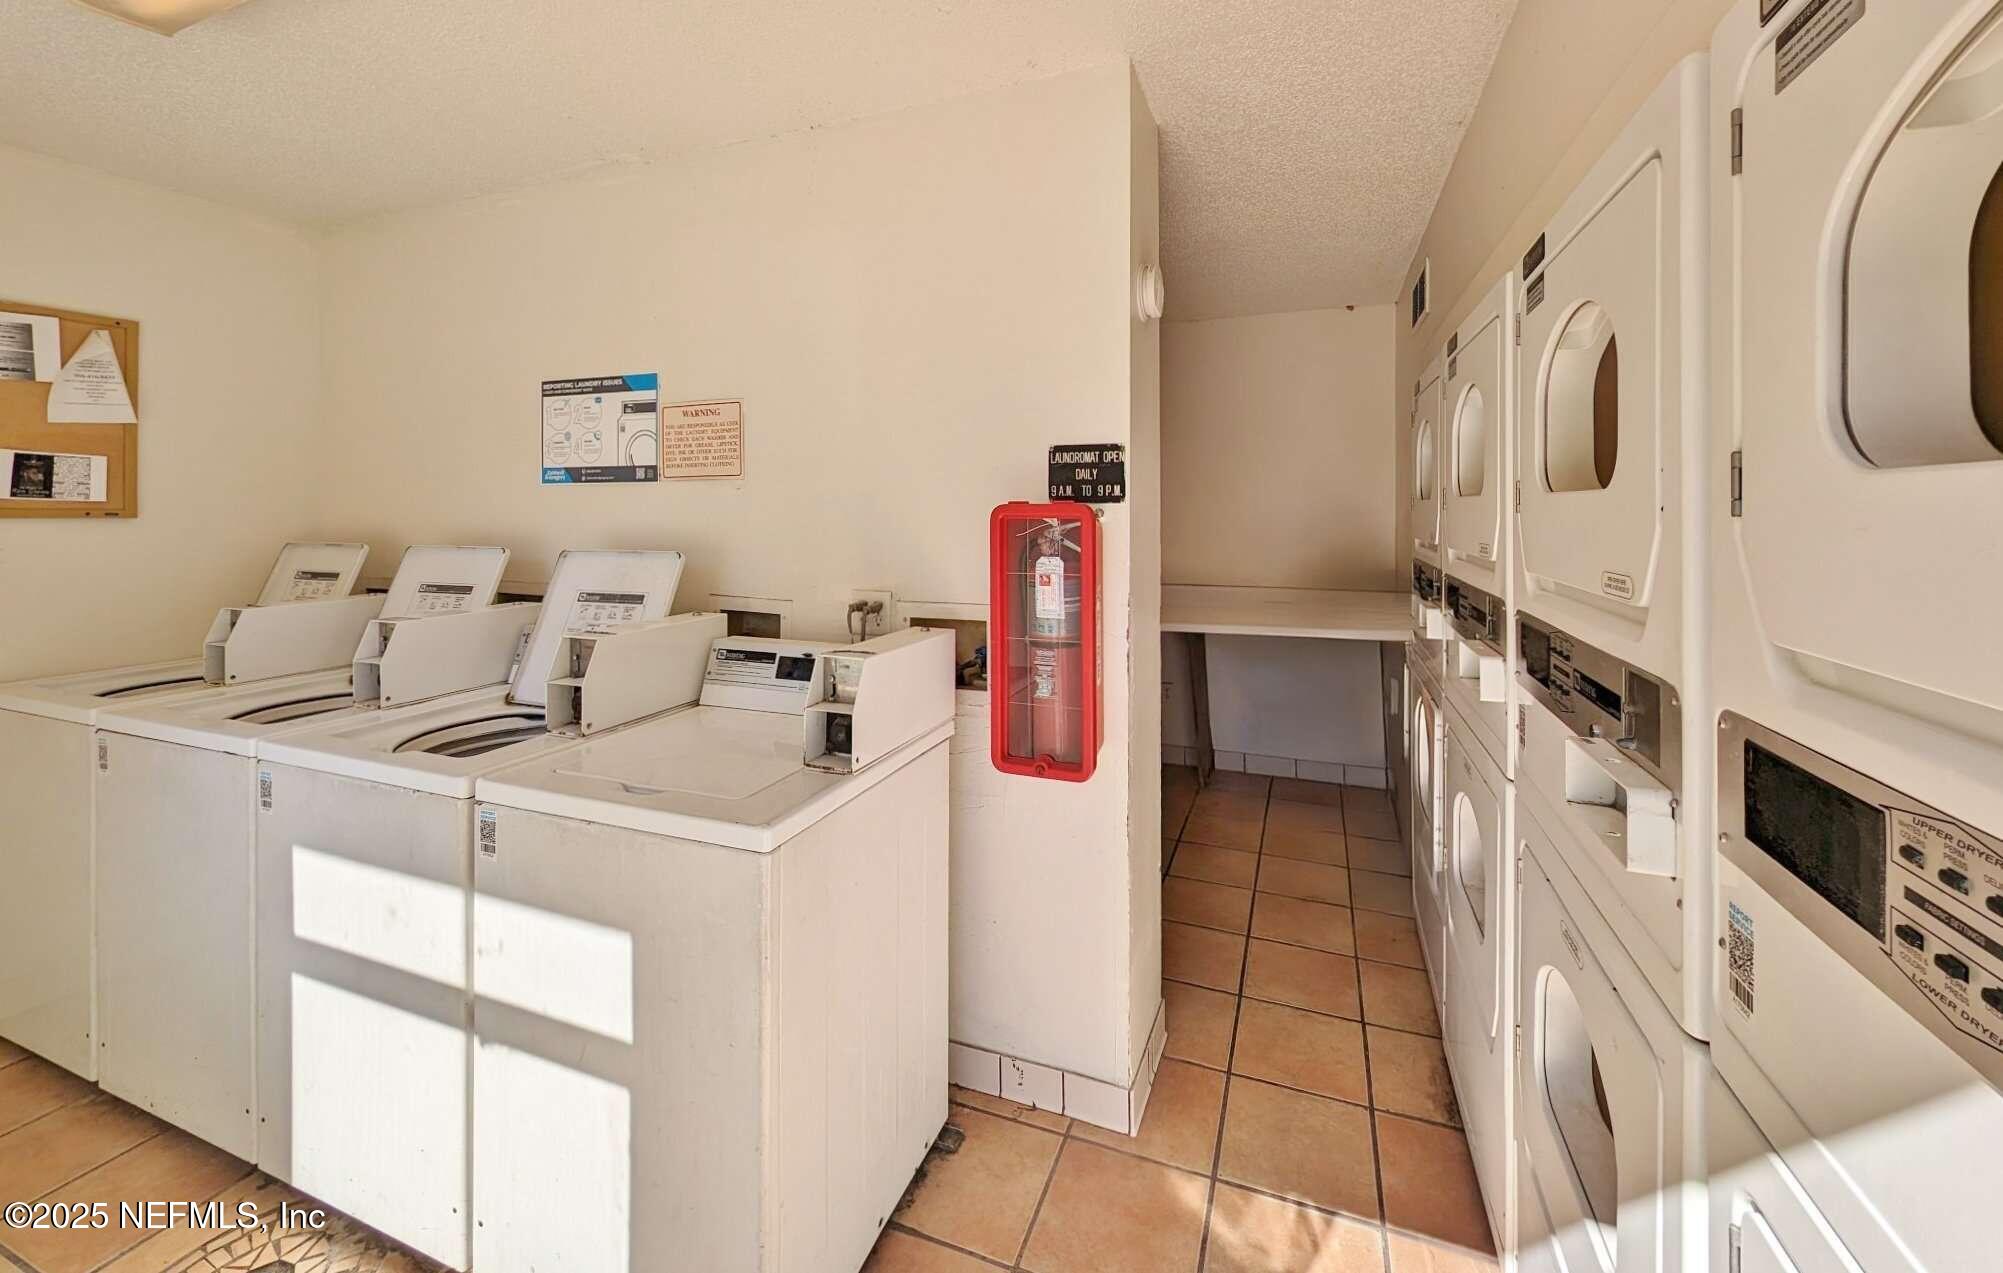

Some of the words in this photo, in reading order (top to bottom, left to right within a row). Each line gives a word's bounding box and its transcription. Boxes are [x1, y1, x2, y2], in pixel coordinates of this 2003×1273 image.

[543, 382, 573, 390] REPORTING
[682, 408, 720, 417] WARNING
[1051, 451, 1099, 464] LAUNDROMAT
[1103, 450, 1125, 463] OPEN
[1075, 468, 1098, 480] DAILY
[1051, 485, 1056, 497] 9
[1082, 485, 1092, 497] TO
[1097, 485, 1103, 496] 9
[1105, 484, 1123, 497] P.M.
[1913, 817, 1953, 843] UPPER
[1957, 840, 2003, 870] DRYER
[1944, 852, 1968, 871] PRESS
[1912, 973, 1957, 1012] LOWER
